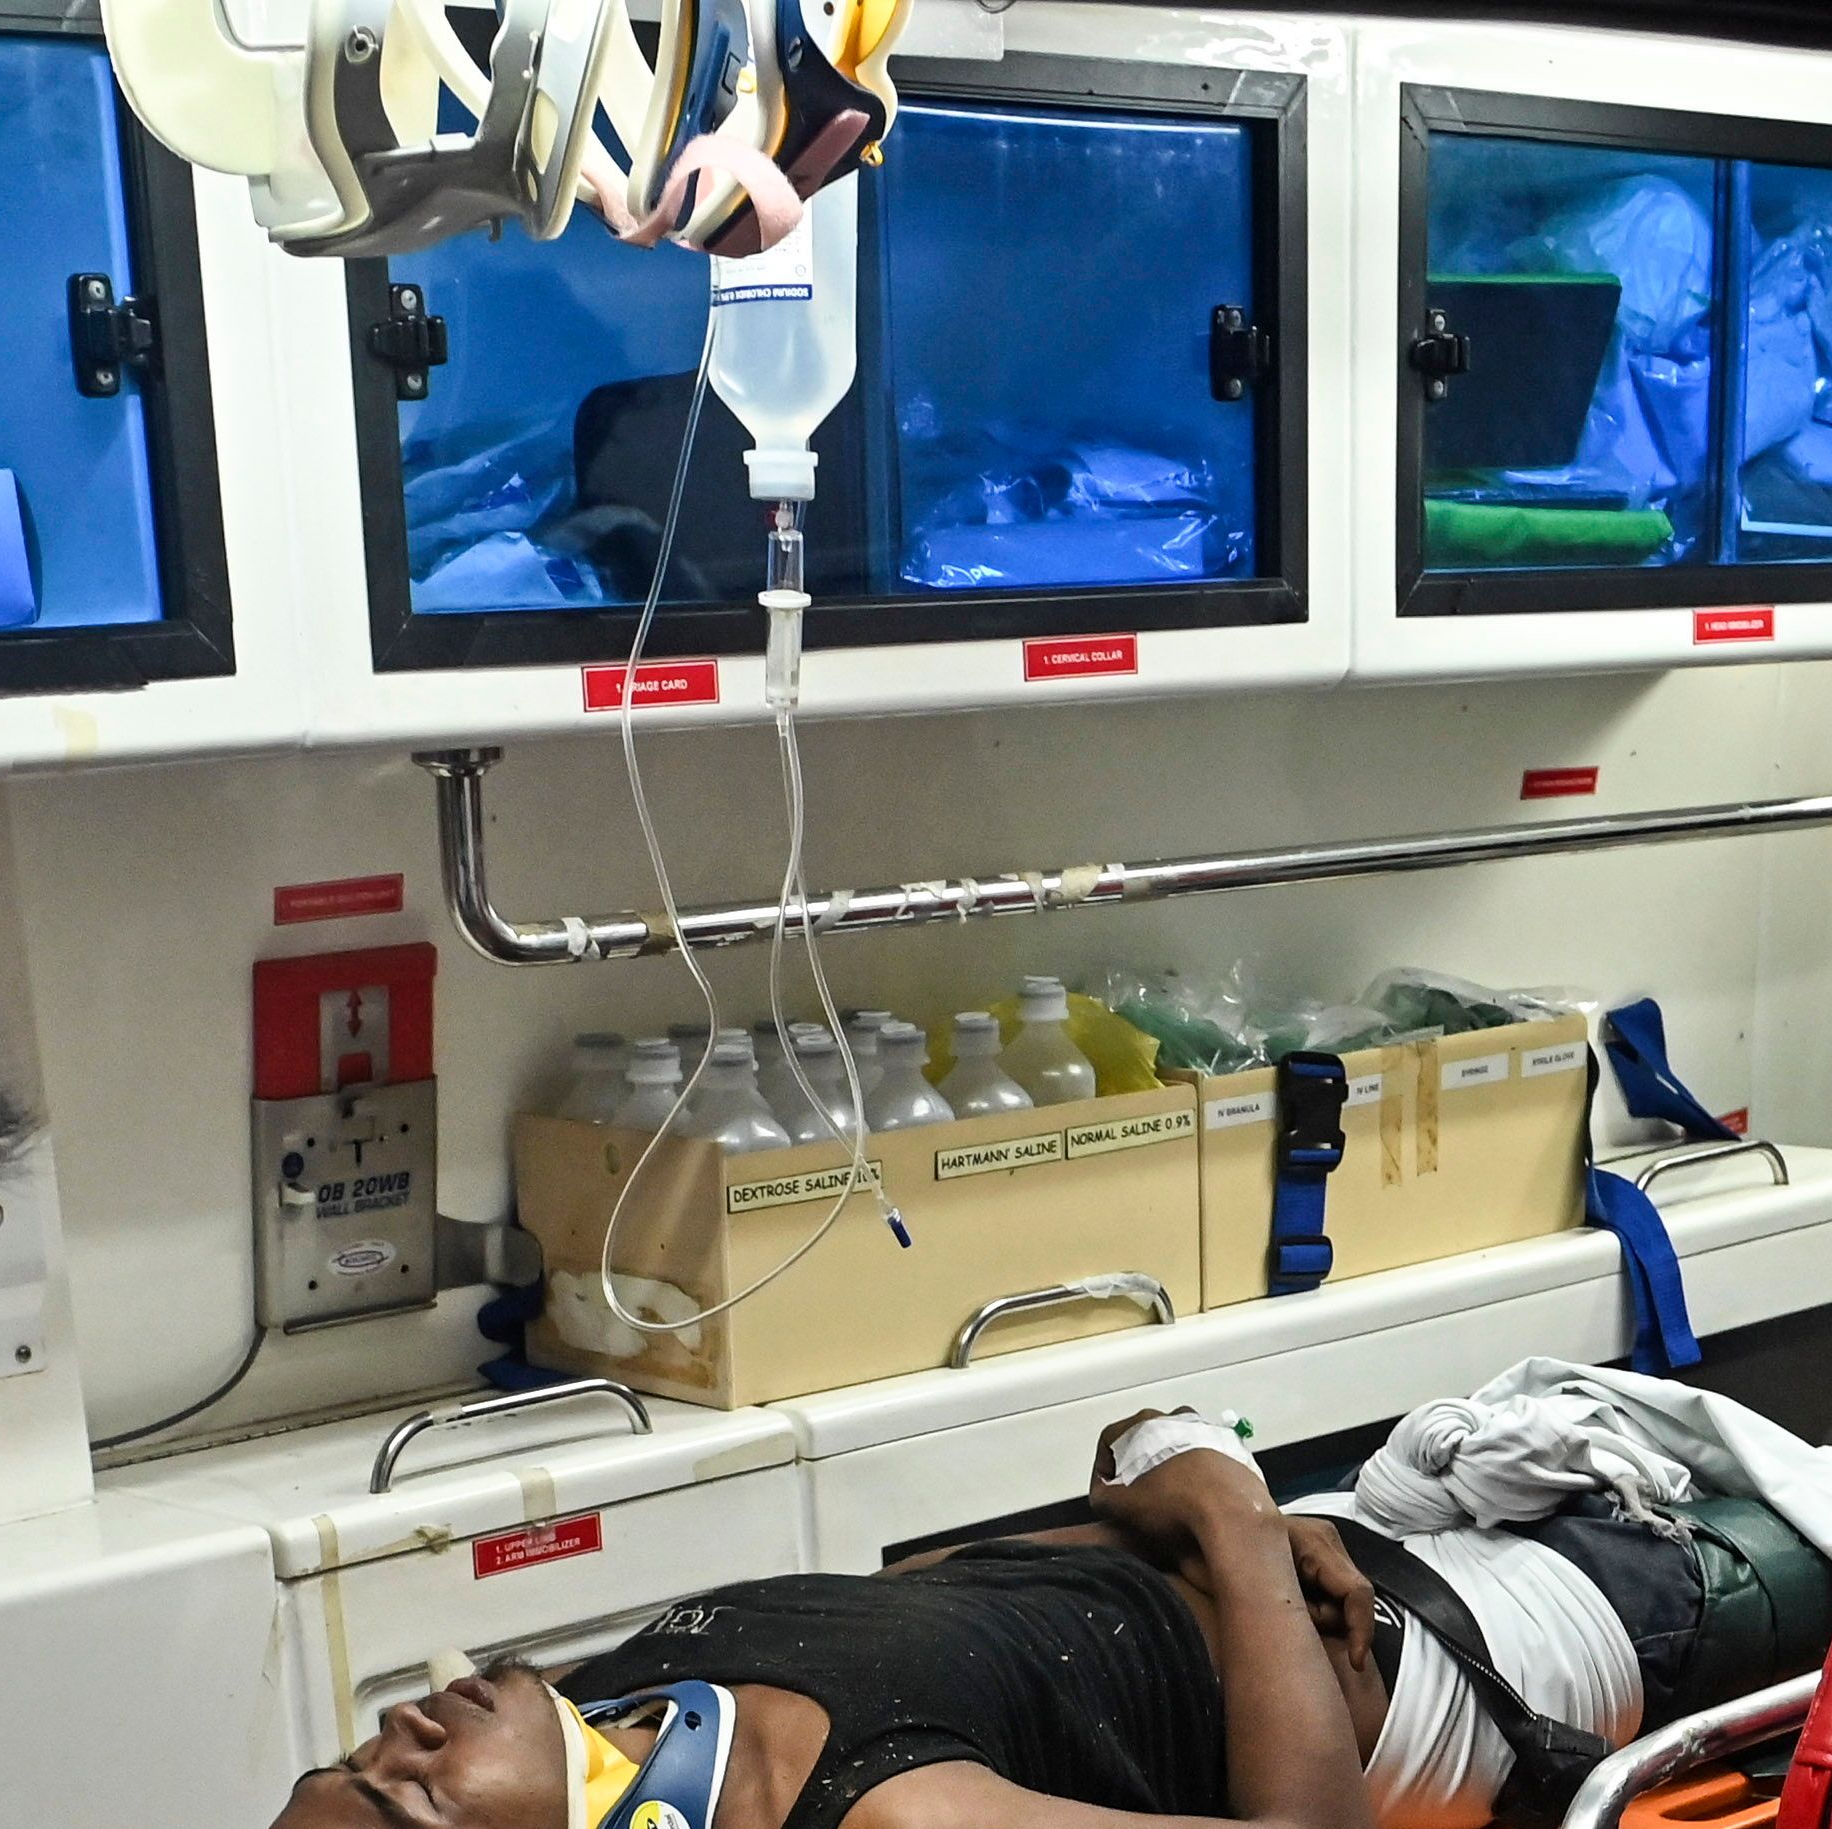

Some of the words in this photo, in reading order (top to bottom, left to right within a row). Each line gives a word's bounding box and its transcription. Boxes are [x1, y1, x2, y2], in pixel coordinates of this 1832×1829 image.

[1051, 653, 1090, 664] CERVICAL
[1091, 650, 1123, 662] COLLAR
[627, 681, 659, 693] RIAGE
[661, 678, 688, 691] CARD
[1070, 1128, 1117, 1148] NORMAL
[1121, 1118, 1161, 1138] SALINE
[1015, 1140, 1057, 1159] SALINE
[352, 1171, 410, 1198] 20WB
[733, 1179, 800, 1203] DEXTROSE
[805, 1170, 851, 1192] SALINE
[505, 1551, 525, 1563] ARM
[526, 1537, 581, 1557] IMMOBILIZER
